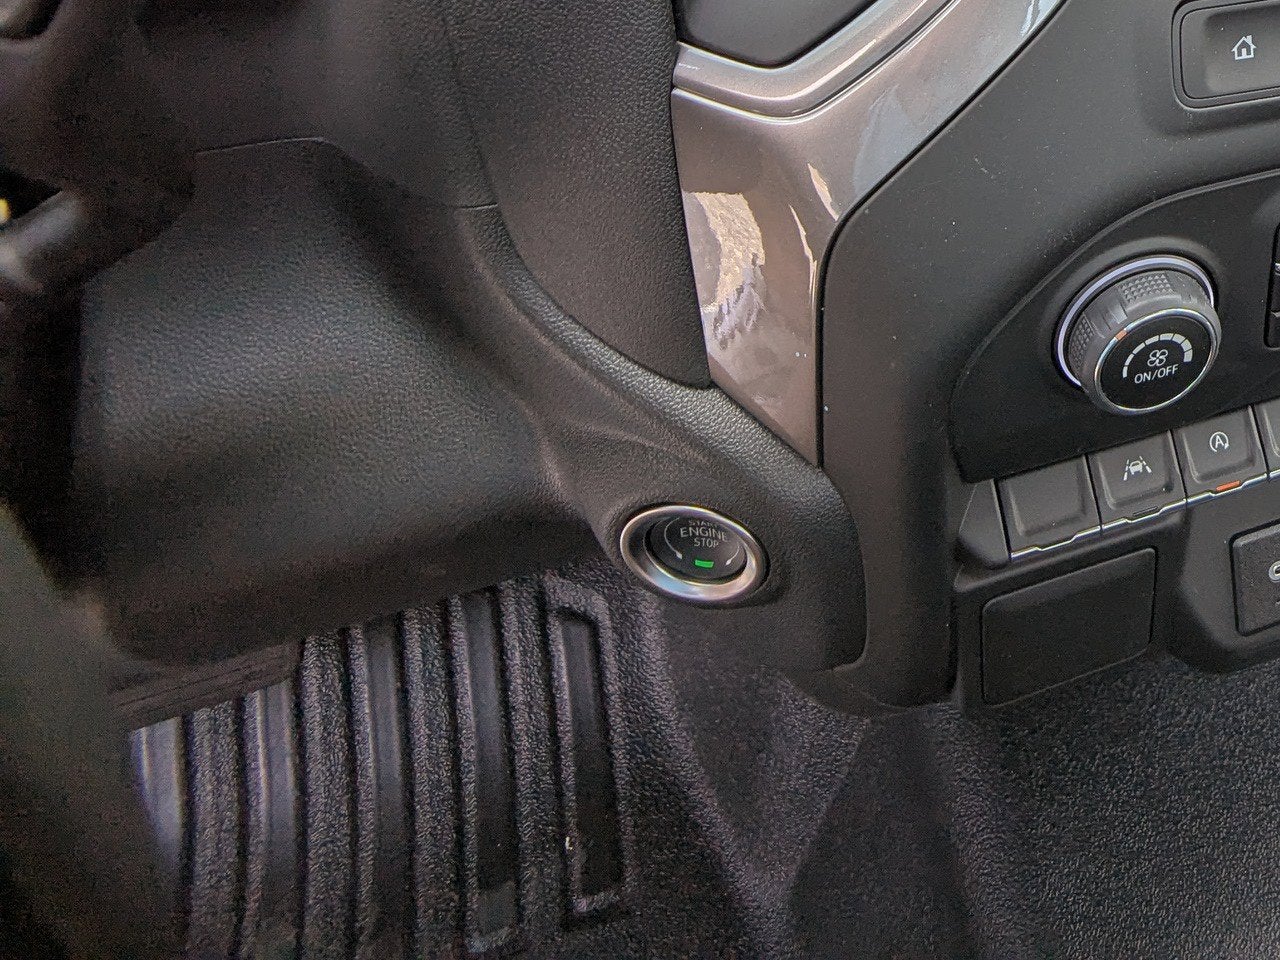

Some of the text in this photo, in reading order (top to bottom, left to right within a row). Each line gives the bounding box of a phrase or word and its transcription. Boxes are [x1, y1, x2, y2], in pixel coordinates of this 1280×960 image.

[1134, 364, 1179, 384] ON/OFF
[680, 526, 728, 543] ENGINE
[694, 536, 719, 548] STOP
